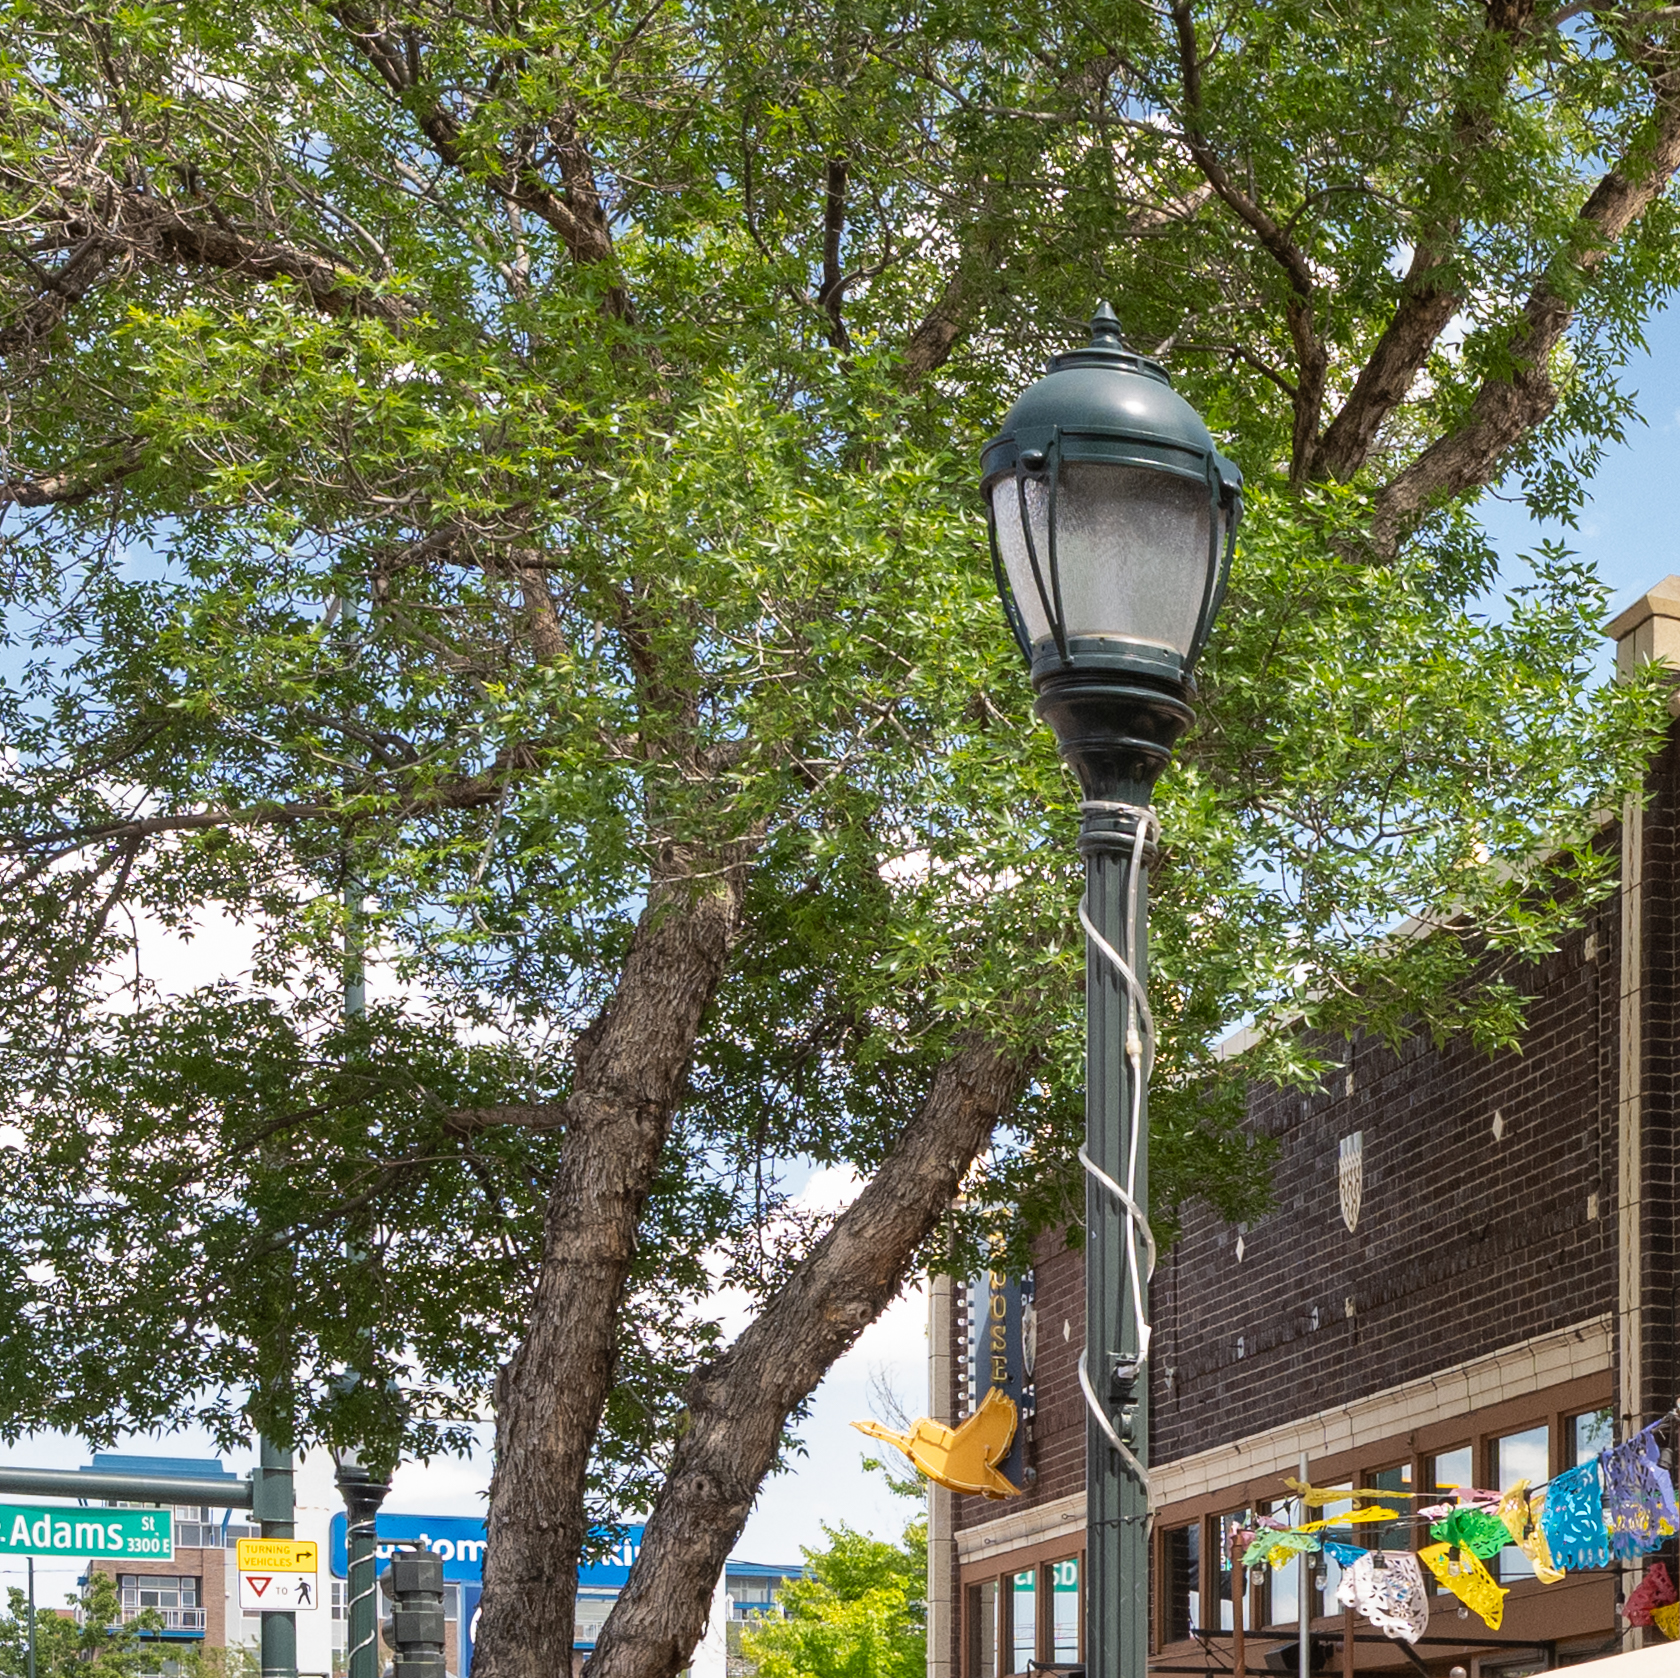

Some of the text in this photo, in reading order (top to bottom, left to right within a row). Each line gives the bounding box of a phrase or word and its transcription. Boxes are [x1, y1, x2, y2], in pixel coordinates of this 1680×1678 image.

[9, 1513, 124, 1551] Adams
[127, 1537, 170, 1553] 3300 E
[245, 1544, 290, 1554] TURNING
[243, 1557, 292, 1567] VEHICLES
[275, 1586, 288, 1595] TO
